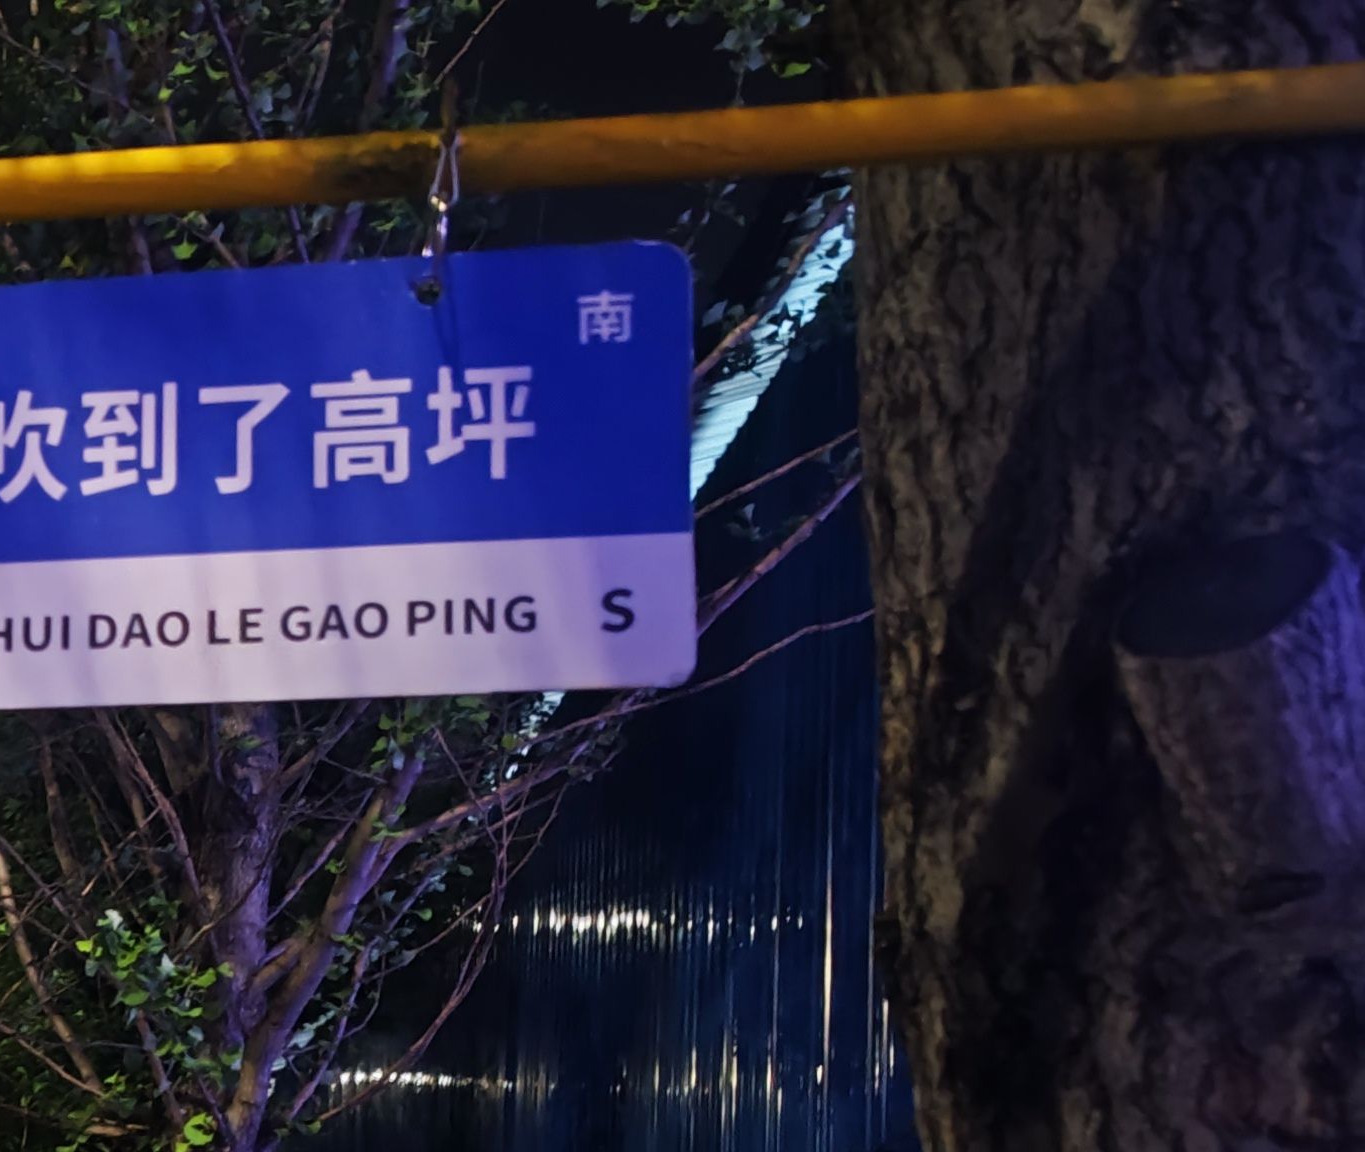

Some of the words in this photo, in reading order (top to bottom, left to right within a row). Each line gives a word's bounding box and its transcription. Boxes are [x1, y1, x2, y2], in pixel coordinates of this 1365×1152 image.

[577, 290, 634, 345] 南
[87, 610, 191, 649] DAO
[207, 608, 264, 645] LE
[279, 602, 389, 642] GAO
[406, 595, 537, 637] PING
[600, 588, 635, 633] S
